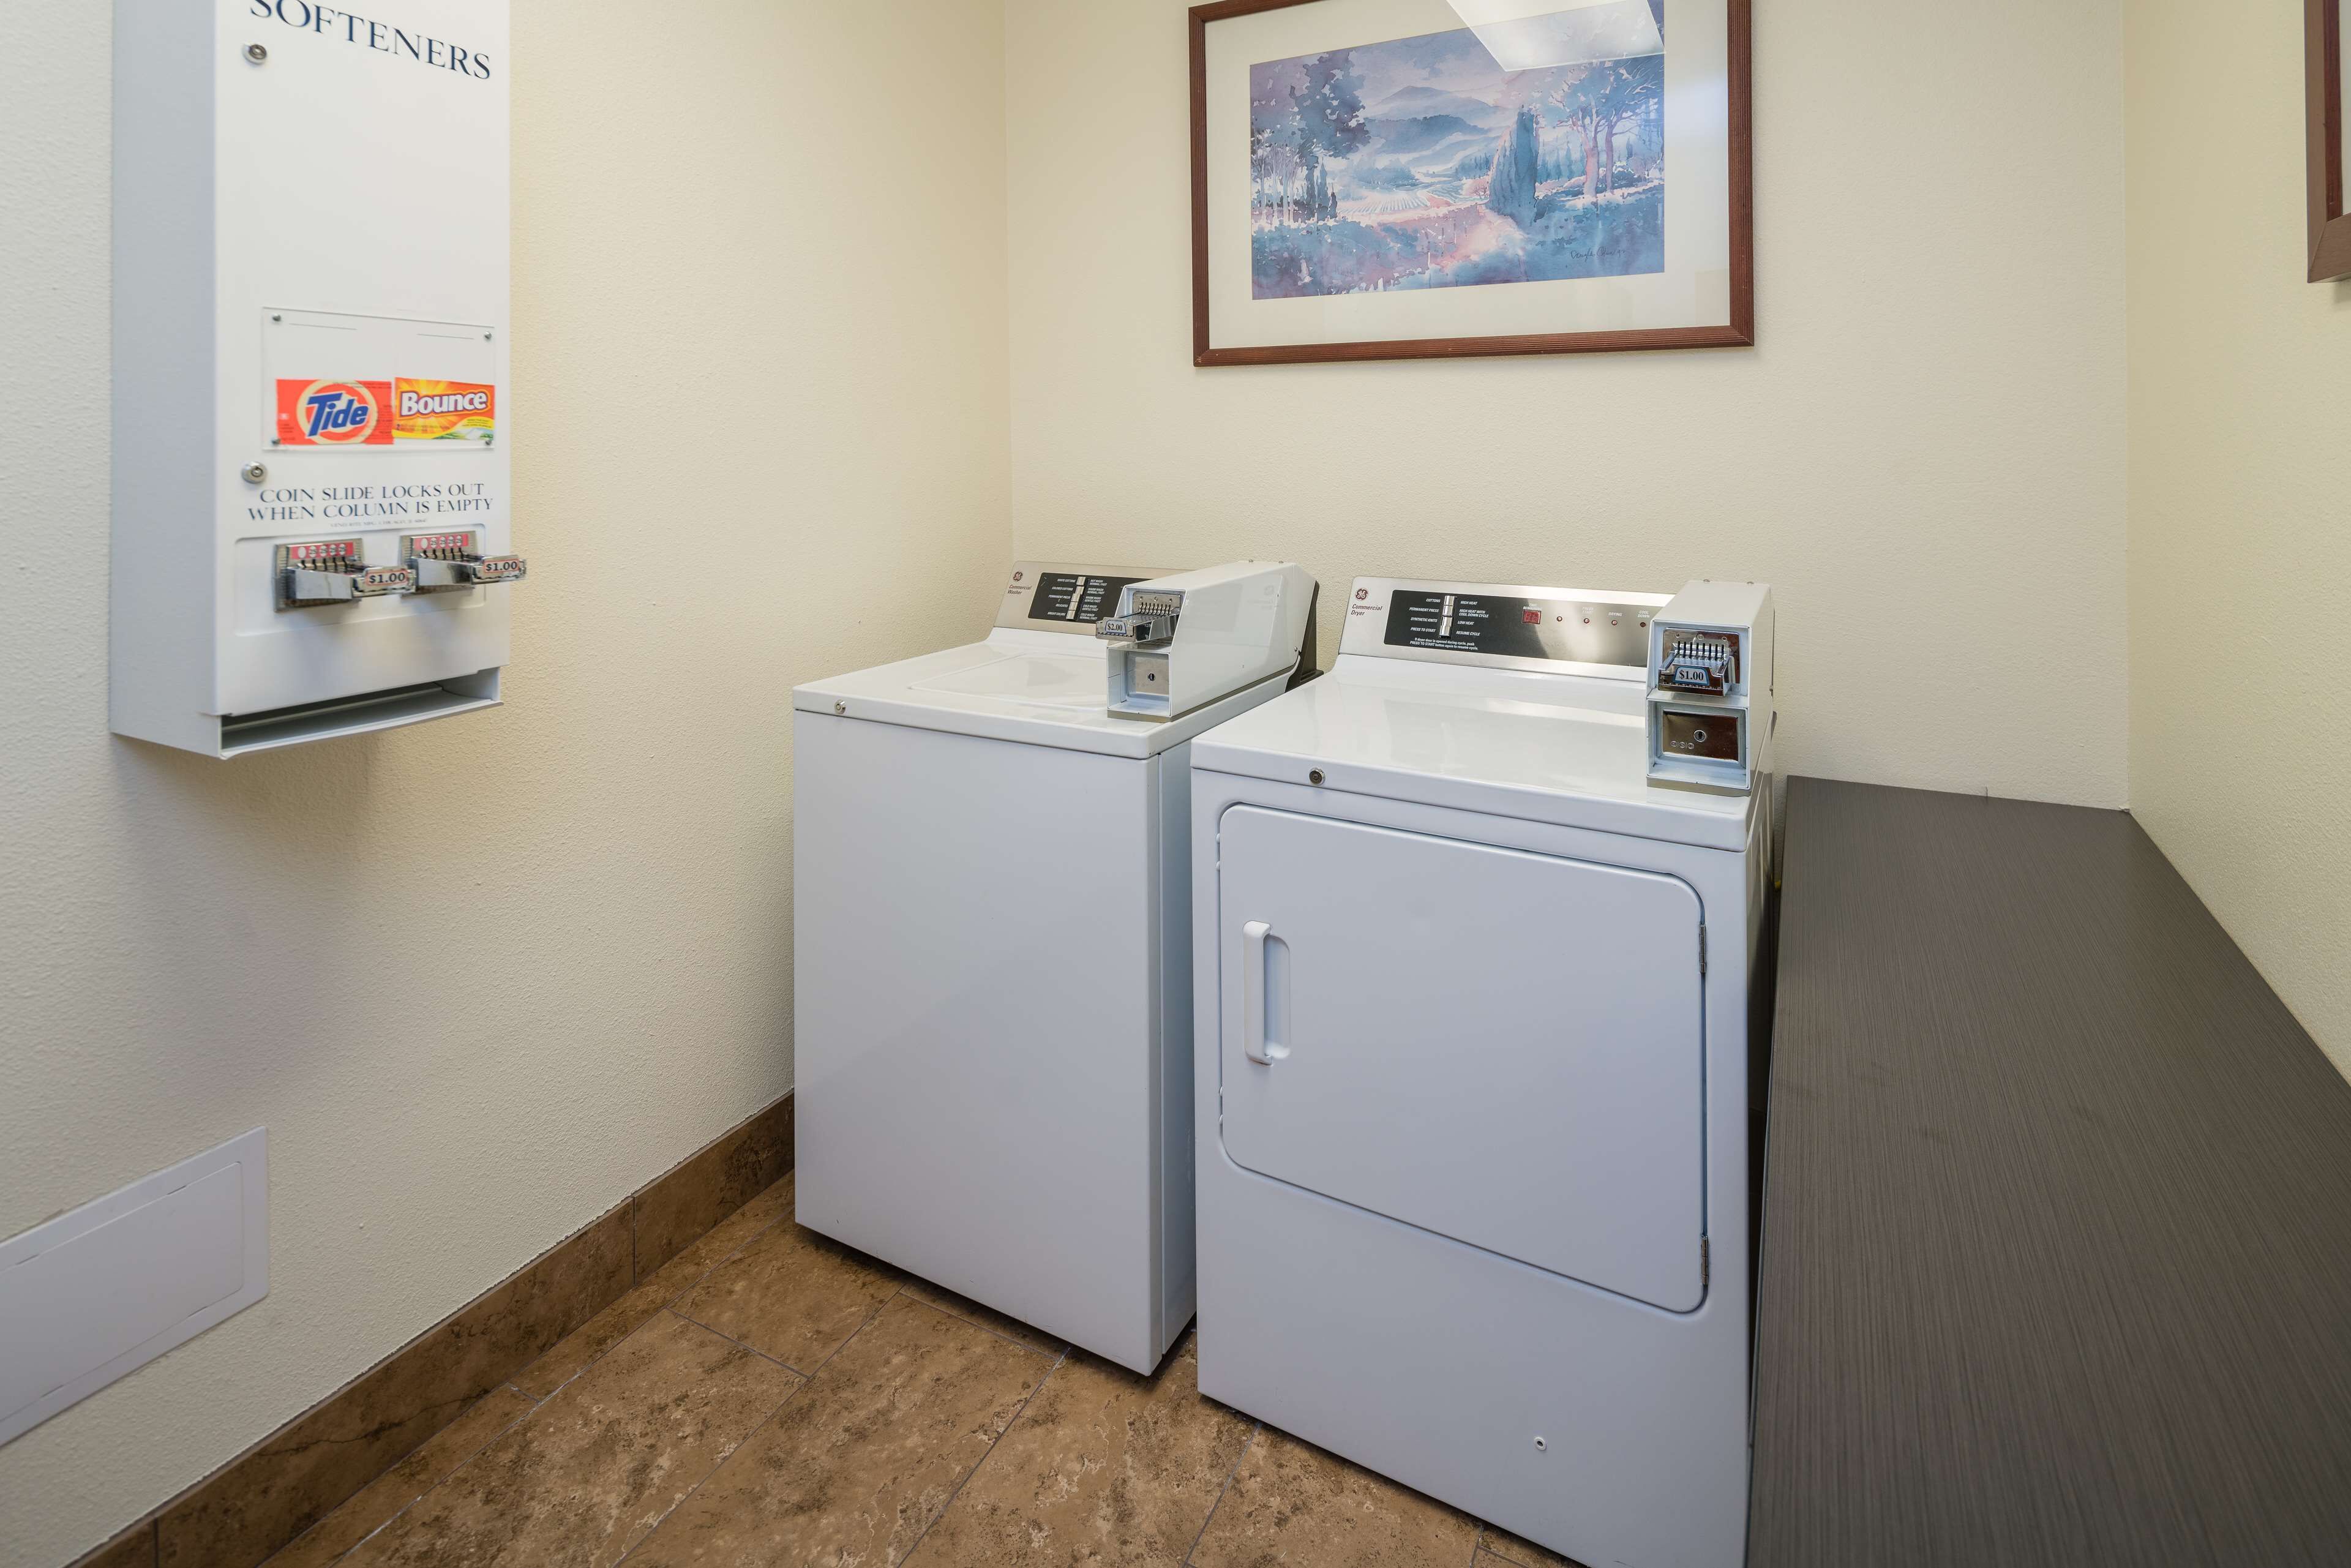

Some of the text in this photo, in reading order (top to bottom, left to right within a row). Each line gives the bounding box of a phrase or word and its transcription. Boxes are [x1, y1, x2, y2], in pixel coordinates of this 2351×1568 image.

[250, 0, 490, 80] SOFTENERS
[306, 392, 369, 437] Tide
[401, 391, 488, 417] Bounce
[260, 483, 485, 504] COIN SLIDE LOCKS OUT
[248, 498, 493, 521] WHEN COLUMN IS EMPTY
[485, 561, 518, 572] $1.00
[369, 572, 406, 584] $1.00
[1679, 670, 1704, 681] $1.00
